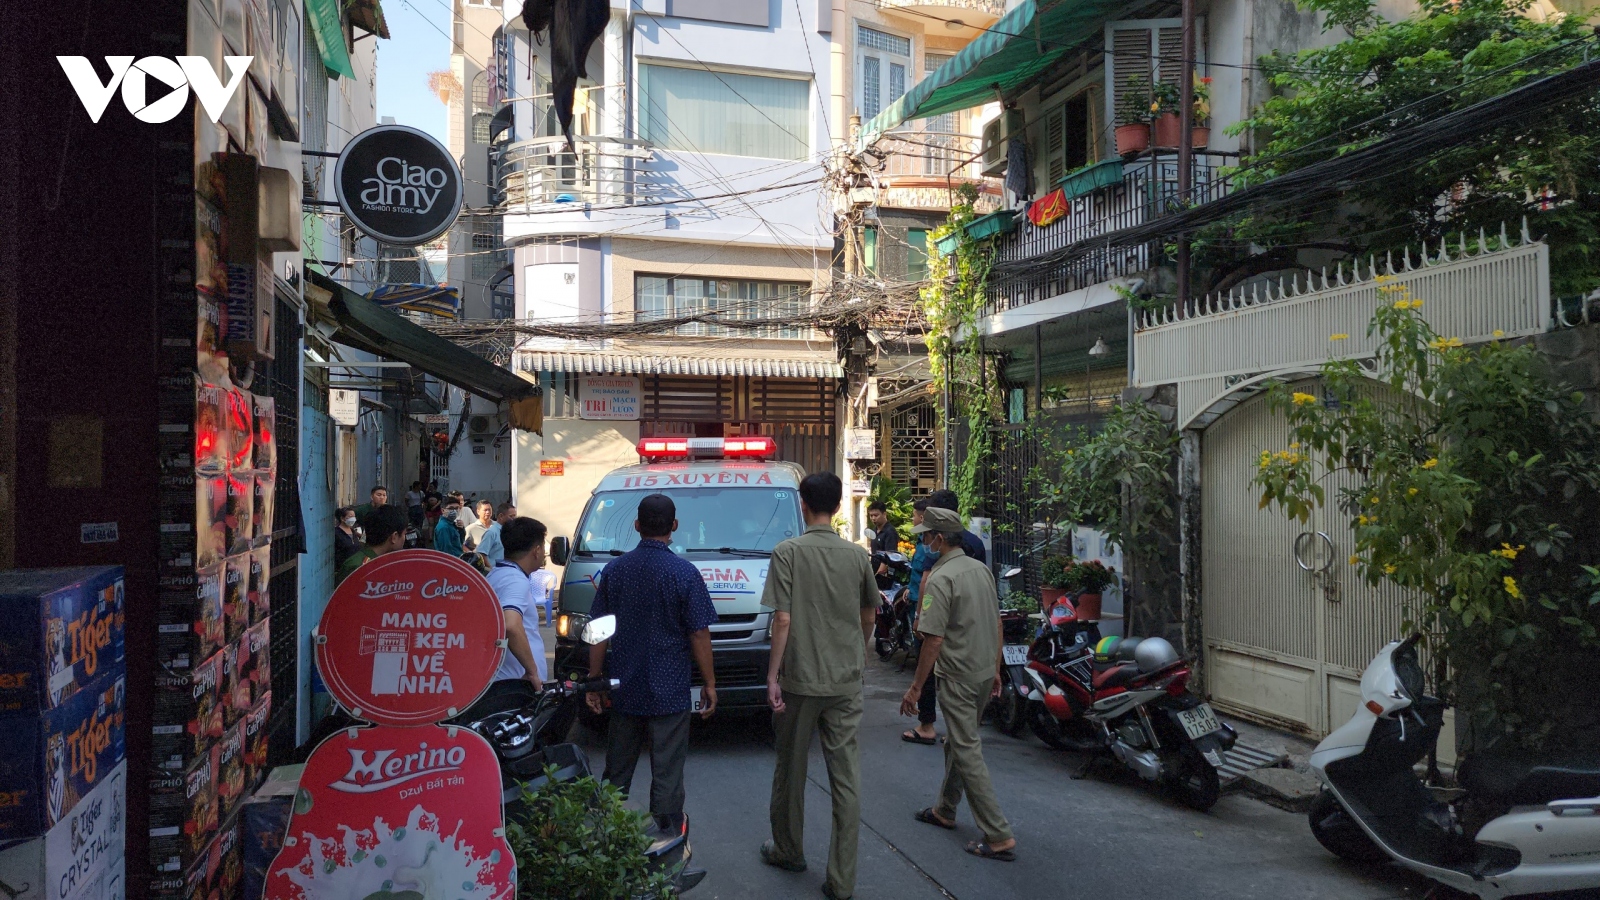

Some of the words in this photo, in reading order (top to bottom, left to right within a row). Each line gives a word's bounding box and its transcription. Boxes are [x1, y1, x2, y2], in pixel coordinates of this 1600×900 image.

[376, 157, 447, 188] Ciao
[360, 178, 441, 215] amy
[362, 204, 391, 212] FASHION
[613, 397, 636, 405] MẠCH
[623, 475, 658, 488] 115
[664, 471, 749, 486] XUYÊN
[755, 471, 772, 485] Á
[363, 579, 414, 595] Merino
[420, 578, 469, 598] Celano
[381, 613, 447, 628] MANG
[68, 604, 113, 676] Tiger
[415, 633, 465, 648] KEM
[412, 651, 446, 673] VỀ
[399, 672, 453, 694] NHÀ
[67, 709, 113, 783] Tiger
[343, 742, 467, 783] Merino
[399, 783, 424, 800] Dzui
[426, 778, 443, 790] Bất
[447, 775, 465, 786] Tận
[80, 797, 102, 836] Tiger
[59, 829, 109, 899] CRYSTAL
